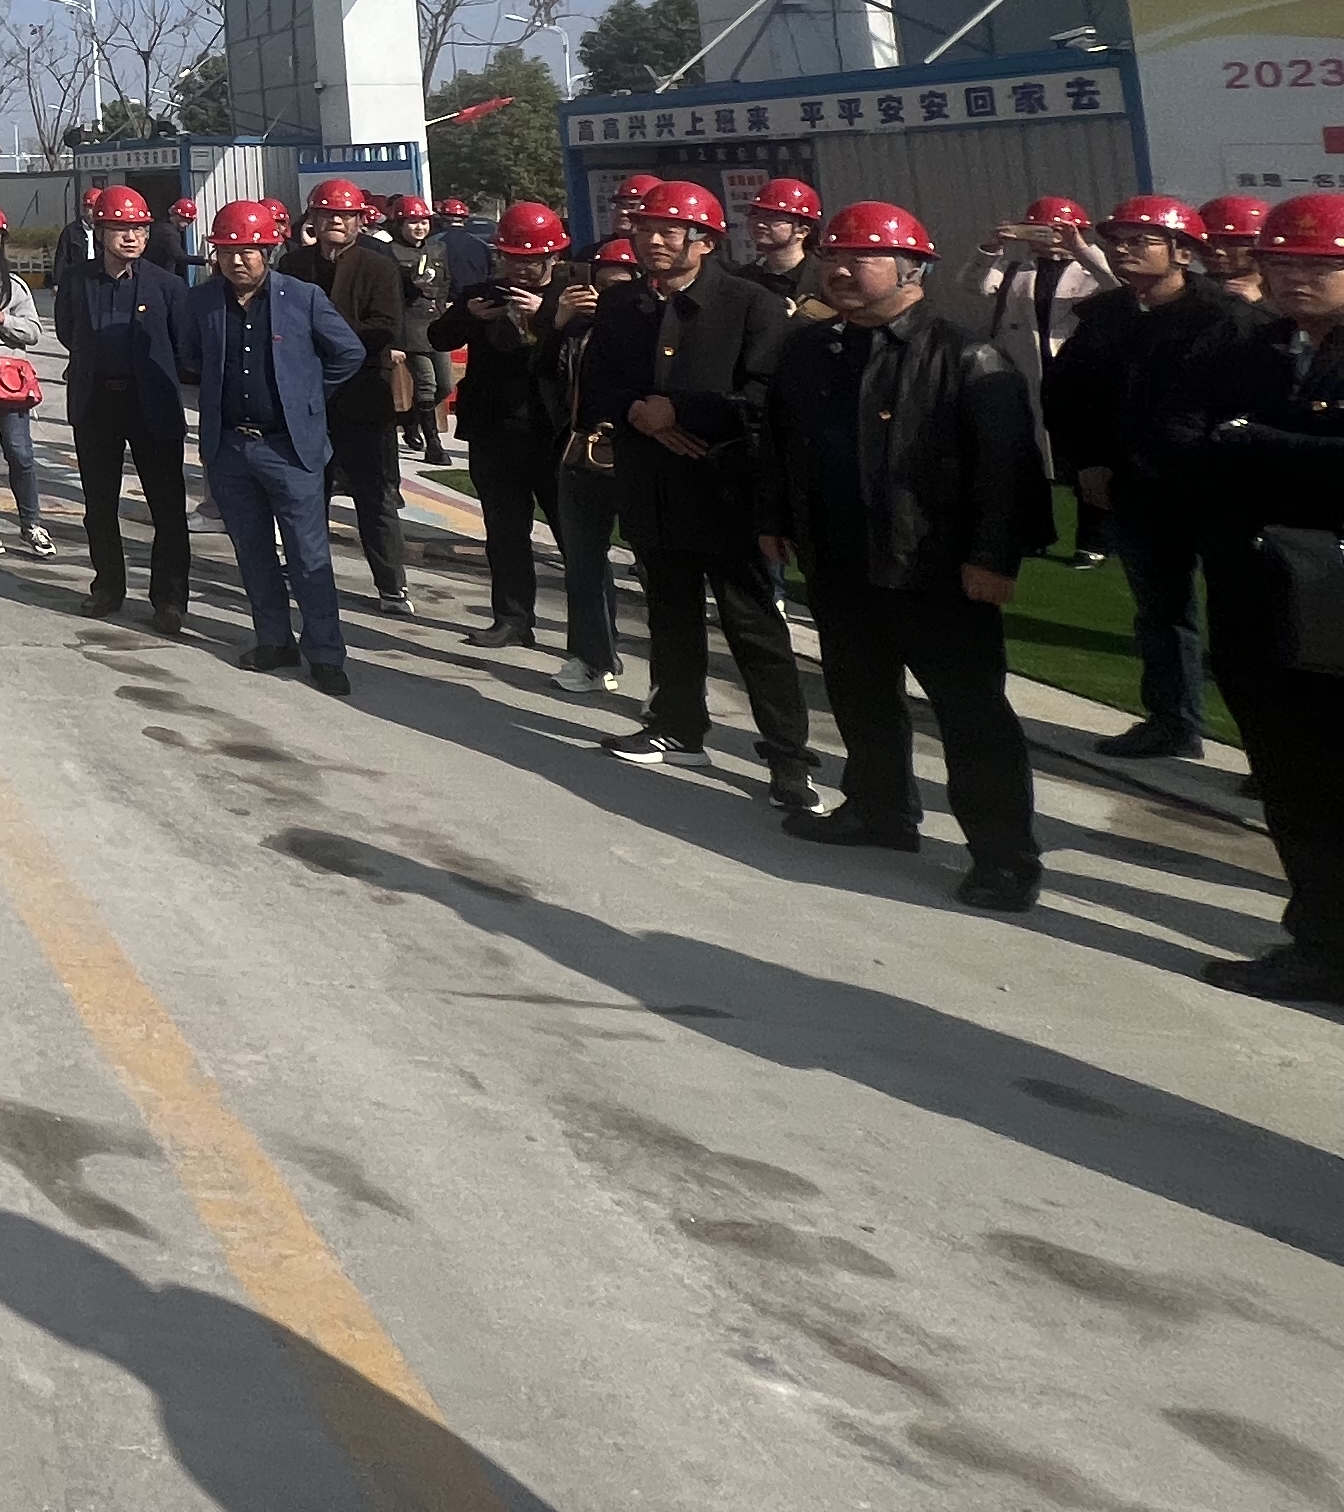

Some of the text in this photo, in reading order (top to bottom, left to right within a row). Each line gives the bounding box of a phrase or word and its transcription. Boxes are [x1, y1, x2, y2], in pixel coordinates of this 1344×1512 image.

[577, 76, 1101, 142] 高高兴兴上班来 平平安安回家去
